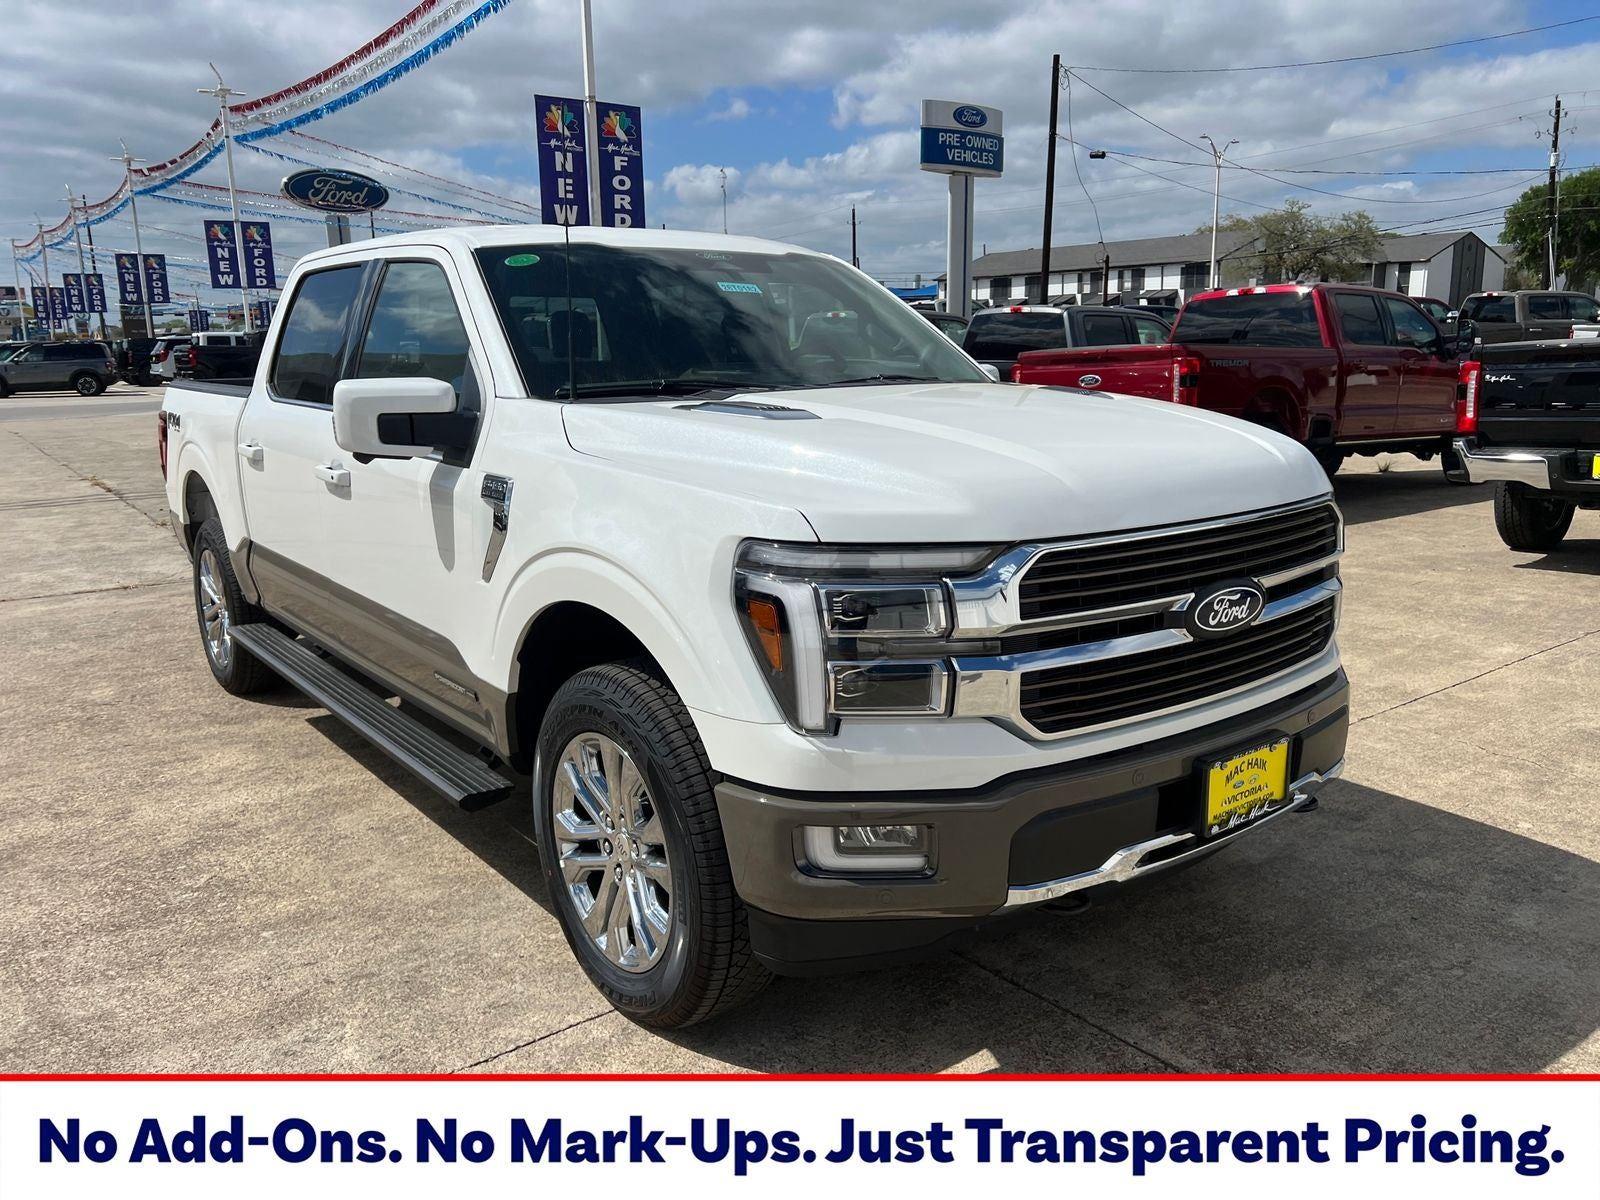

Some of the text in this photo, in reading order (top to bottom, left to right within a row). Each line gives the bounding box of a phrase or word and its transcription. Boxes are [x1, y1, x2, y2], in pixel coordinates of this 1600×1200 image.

[961, 109, 982, 124] Ford
[938, 132, 999, 151] PRE-OWNED
[946, 147, 994, 165] VEHICLES
[308, 176, 368, 206] Ford
[553, 151, 578, 225] NEW
[612, 155, 632, 228] FORD
[216, 247, 234, 286] NEW
[253, 248, 268, 287] FORD
[70, 288, 81, 311] NEW
[92, 288, 102, 311] FORD
[124, 273, 138, 302] NEW
[152, 273, 164, 302] FORD
[1209, 359, 1250, 368] TREMOR
[1208, 593, 1250, 626] Ford
[1225, 760, 1246, 788] MAC
[1246, 757, 1268, 772] HAIK
